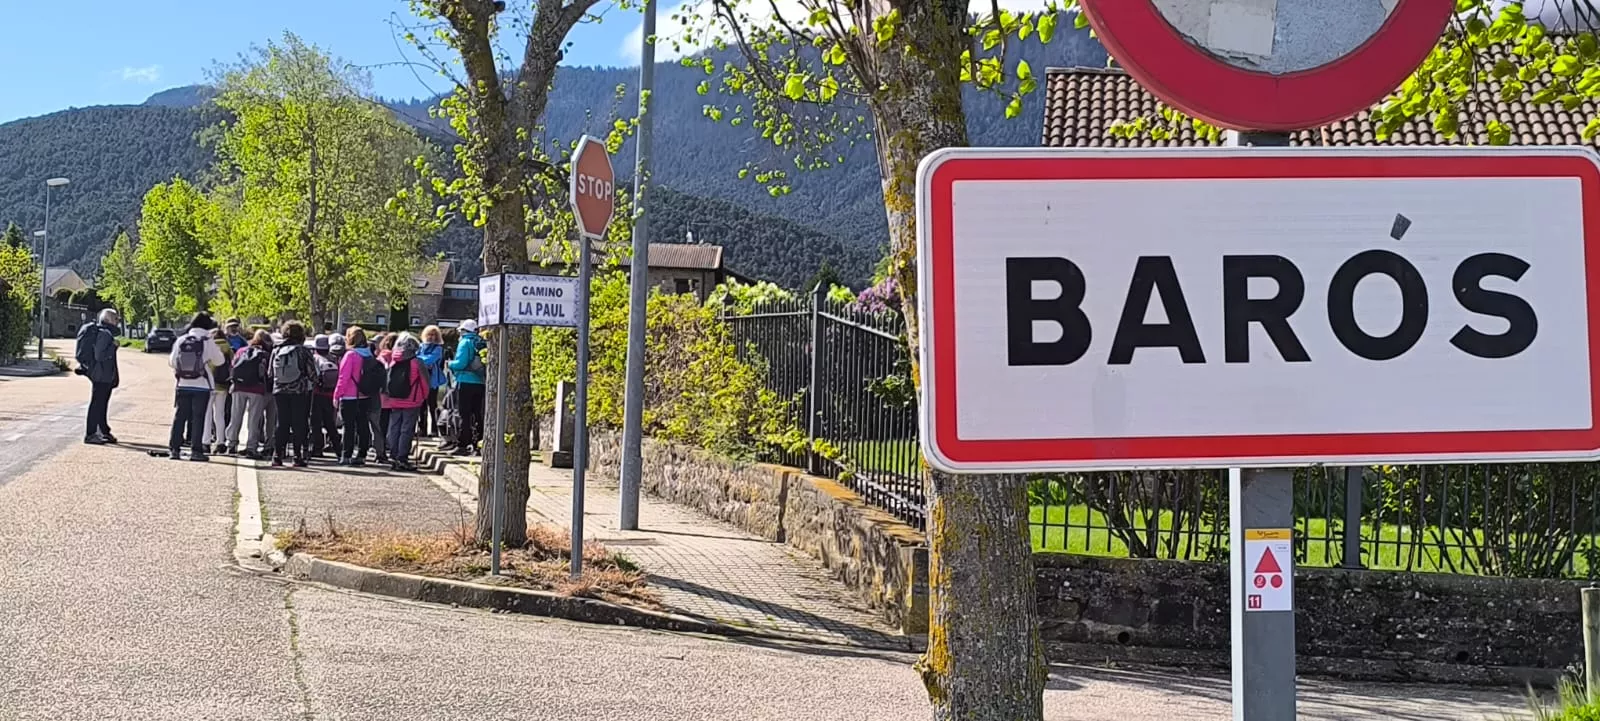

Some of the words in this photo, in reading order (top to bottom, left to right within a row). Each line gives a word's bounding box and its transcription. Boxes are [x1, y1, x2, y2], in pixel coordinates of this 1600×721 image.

[577, 173, 612, 201] STOP
[521, 286, 563, 298] CAMINO
[1005, 213, 1539, 367] BARÓS
[518, 301, 533, 316] LA
[536, 302, 565, 317] PAUL
[1249, 596, 1260, 608] 11
